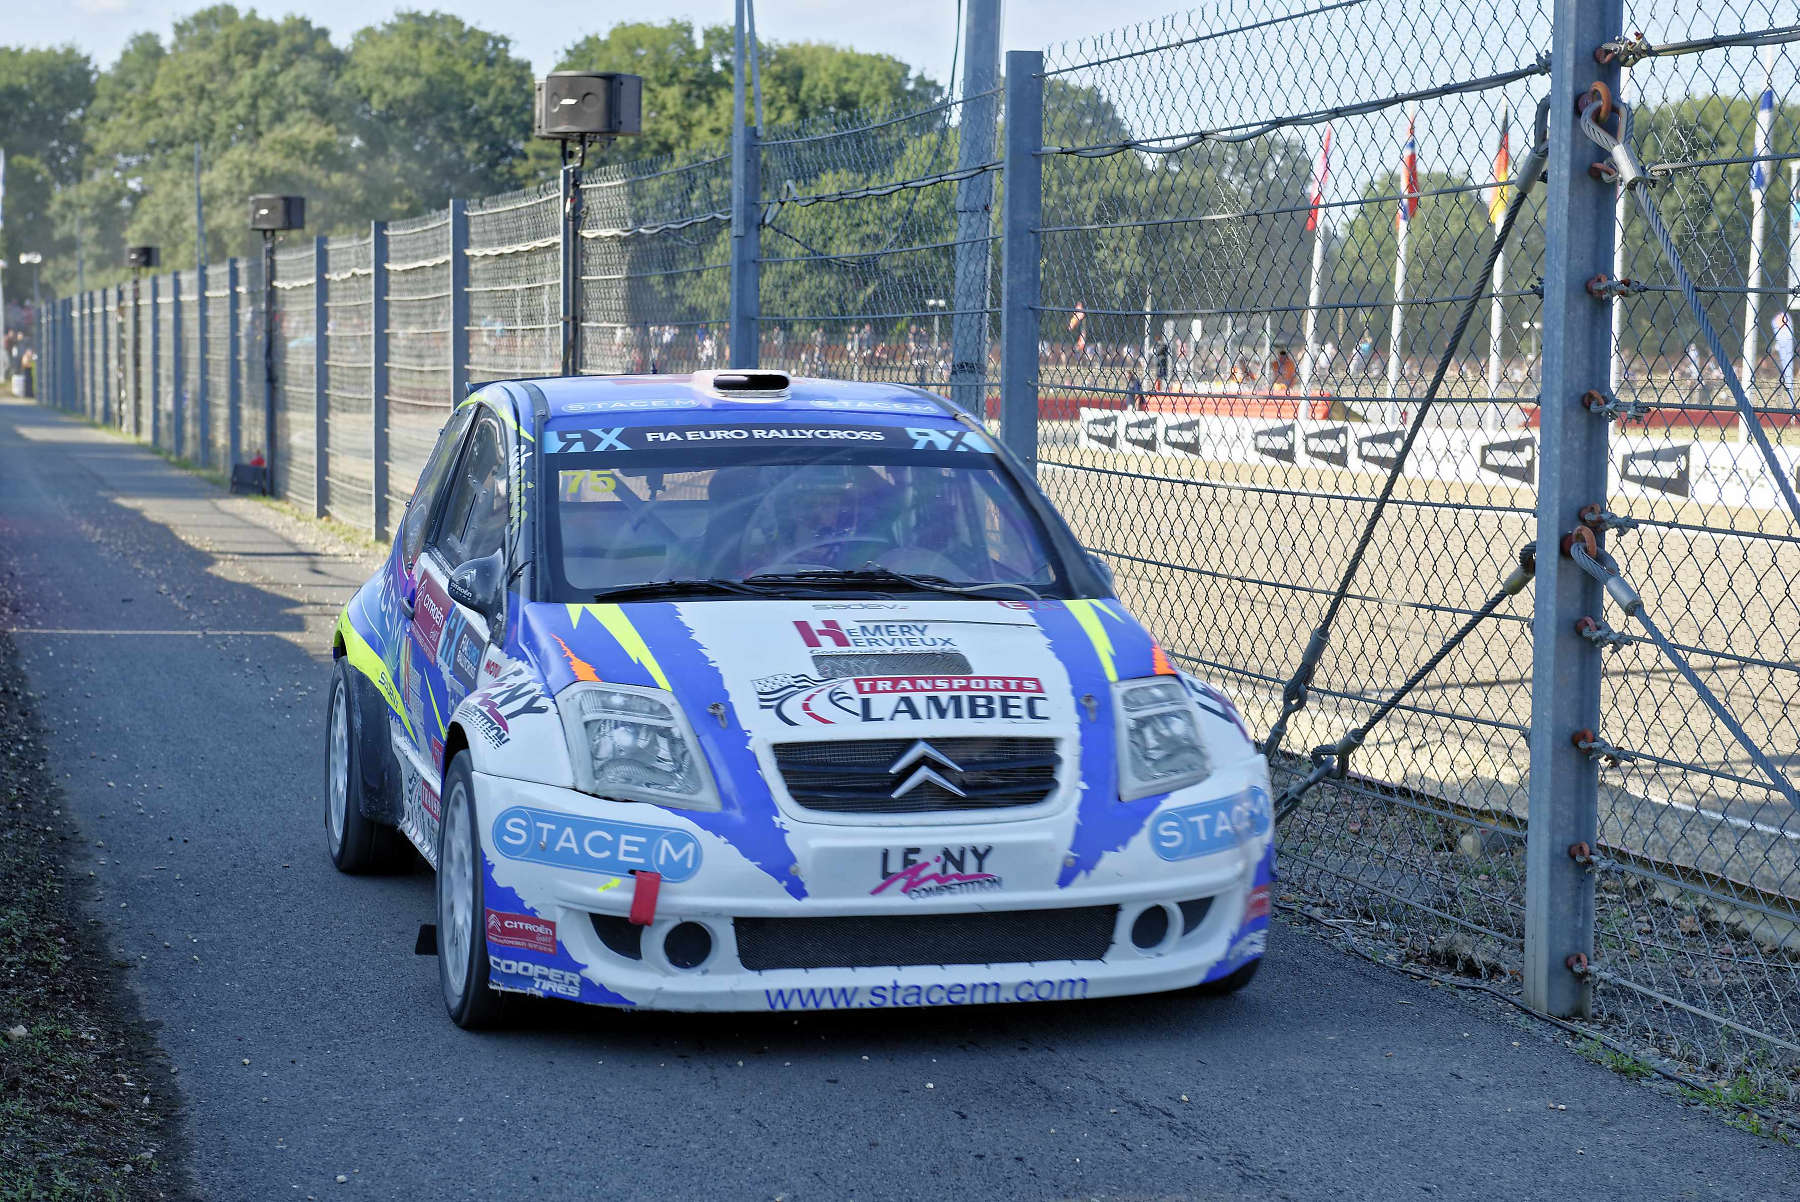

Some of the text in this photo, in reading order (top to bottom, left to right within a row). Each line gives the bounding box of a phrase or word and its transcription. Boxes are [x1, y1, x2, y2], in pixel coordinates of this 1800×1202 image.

[567, 399, 698, 411] STACEM
[646, 429, 885, 442] FIA EURO RALLYCROSS
[562, 470, 616, 493] 75
[859, 679, 1038, 692] TRANSPORTS
[860, 695, 1051, 722] LAMBEC
[502, 816, 695, 869] STACEM
[942, 845, 993, 875] NY
[908, 876, 1002, 900] COMPETITION
[489, 955, 581, 987] COOPER
[533, 976, 581, 998] TIRES
[764, 976, 1089, 1011] www.stacem.com
